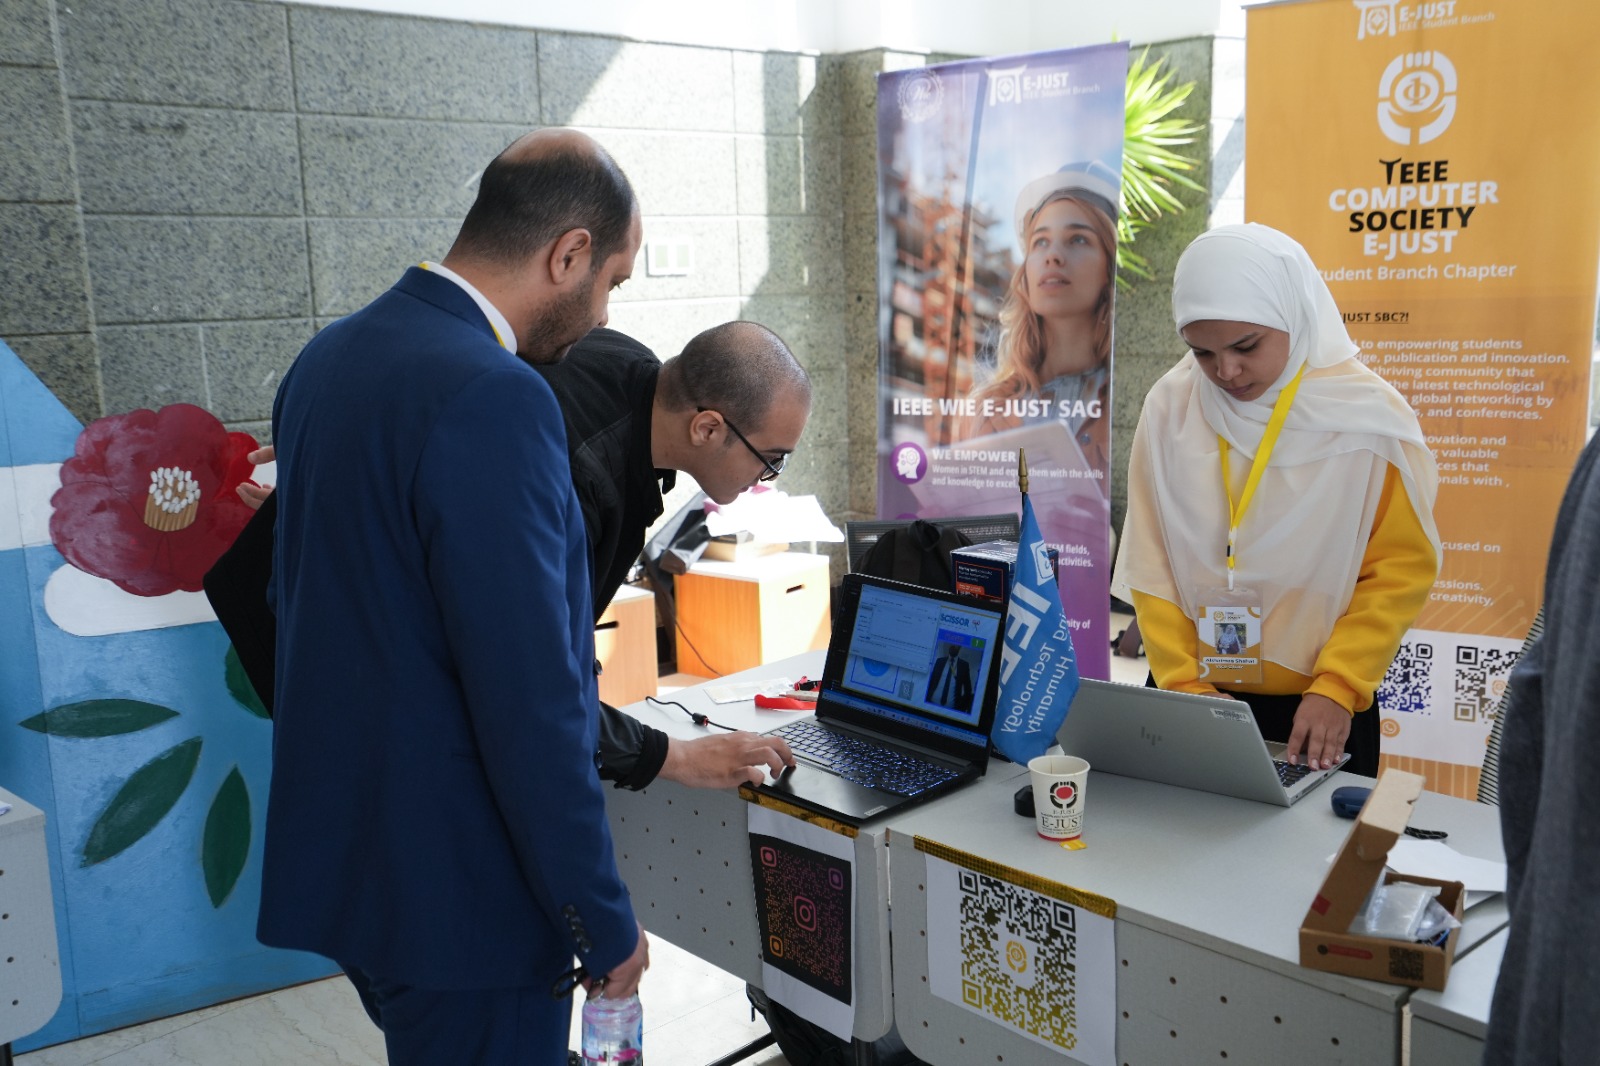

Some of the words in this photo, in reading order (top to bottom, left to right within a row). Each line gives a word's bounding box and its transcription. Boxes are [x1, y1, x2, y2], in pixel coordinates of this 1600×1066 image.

[1399, 0, 1457, 22] E-JUST
[1421, 17, 1459, 29] Student
[1461, 11, 1496, 24] Branch
[1023, 72, 1069, 91] E-JUST
[1073, 84, 1100, 95] Branch
[1328, 181, 1499, 211] COMPUTER
[1349, 206, 1476, 232] SOCIETY
[1363, 230, 1458, 260] E-JUST
[1318, 267, 1373, 282] tudent
[1377, 265, 1438, 281] Branch
[1443, 263, 1517, 284] Chapter
[1374, 312, 1409, 323] SBC?!
[1361, 340, 1374, 350] to
[1377, 338, 1459, 351] empowering
[1462, 338, 1523, 350] students
[1384, 352, 1458, 365] publication
[1462, 353, 1487, 363] and
[1491, 353, 1570, 364] innovation.
[1373, 366, 1422, 379] thriving
[1426, 367, 1503, 380] community
[1506, 367, 1535, 378] that
[1412, 380, 1450, 391] latest
[1453, 380, 1544, 393] technological
[1411, 393, 1451, 405] global
[1455, 393, 1534, 406] networking
[1537, 394, 1554, 407] by
[892, 398, 933, 416] IEEE
[938, 398, 976, 417] WIE
[983, 399, 1051, 419] E-JUST
[1059, 400, 1102, 418] SAG
[1427, 407, 1453, 418] and
[1456, 407, 1542, 420] conferences.
[1481, 435, 1506, 446] and
[932, 449, 952, 462] WE
[954, 450, 1016, 463] EMPOWER
[1441, 449, 1499, 460] valuable
[932, 464, 959, 474] Women
[960, 465, 967, 475] in
[969, 465, 988, 476] STEM
[989, 466, 1003, 476] and
[1005, 467, 1019, 479] equ
[1029, 467, 1048, 478] them
[1050, 468, 1067, 479] with
[1069, 468, 1082, 479] the
[1084, 469, 1103, 480] skills
[1461, 462, 1490, 473] that
[932, 476, 946, 486] and
[947, 477, 984, 489] knowledge
[986, 478, 994, 488] to
[996, 479, 1017, 489] excel.
[1473, 475, 1503, 487] with
[1066, 544, 1090, 556] fields,
[1483, 544, 1501, 553] on
[1432, 579, 1484, 591] essions.
[1430, 592, 1494, 607] creativity,
[941, 614, 970, 628] SCISSOR
[1082, 620, 1091, 630] of
[1041, 814, 1083, 829] E-JUST
